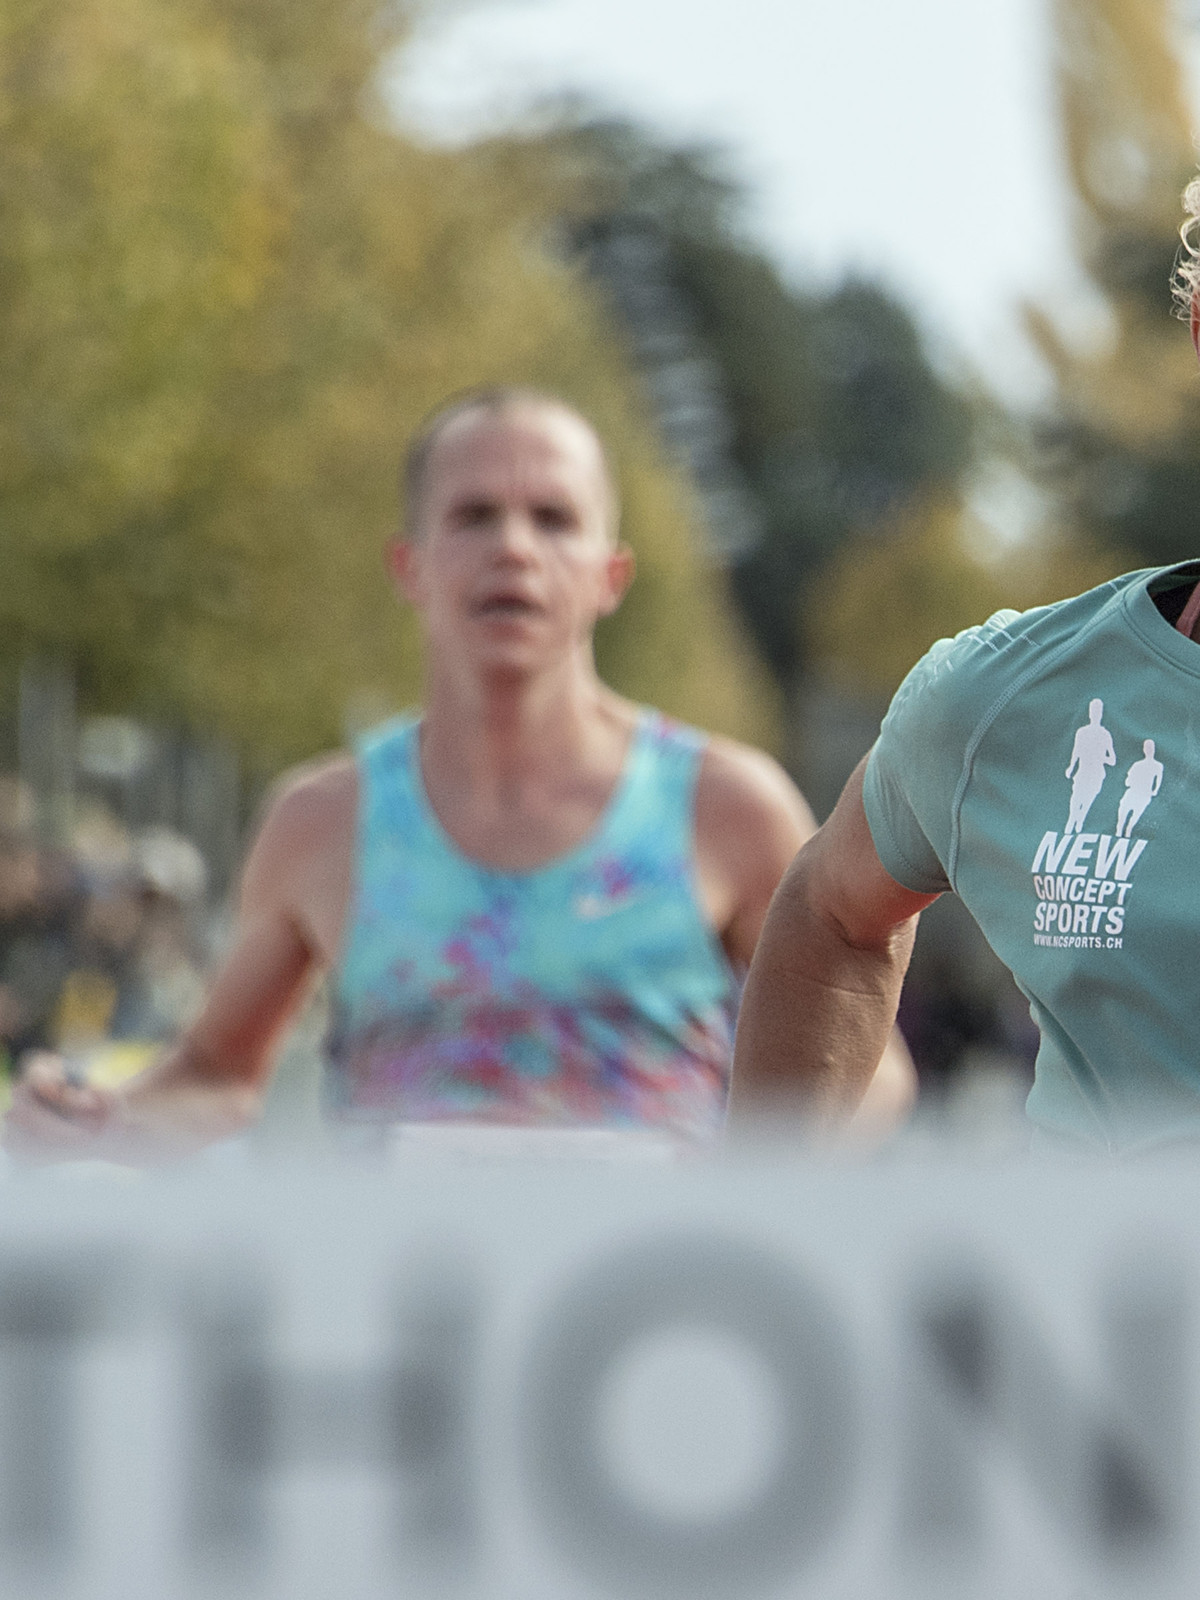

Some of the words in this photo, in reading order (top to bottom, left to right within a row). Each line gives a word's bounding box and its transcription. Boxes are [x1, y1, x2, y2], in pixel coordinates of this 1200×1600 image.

[1031, 830, 1148, 881] NEW
[1033, 875, 1133, 905] CONCEPT
[1033, 902, 1125, 935] SPORTS
[1033, 933, 1123, 949] WWW.NCSPORTS.CH
